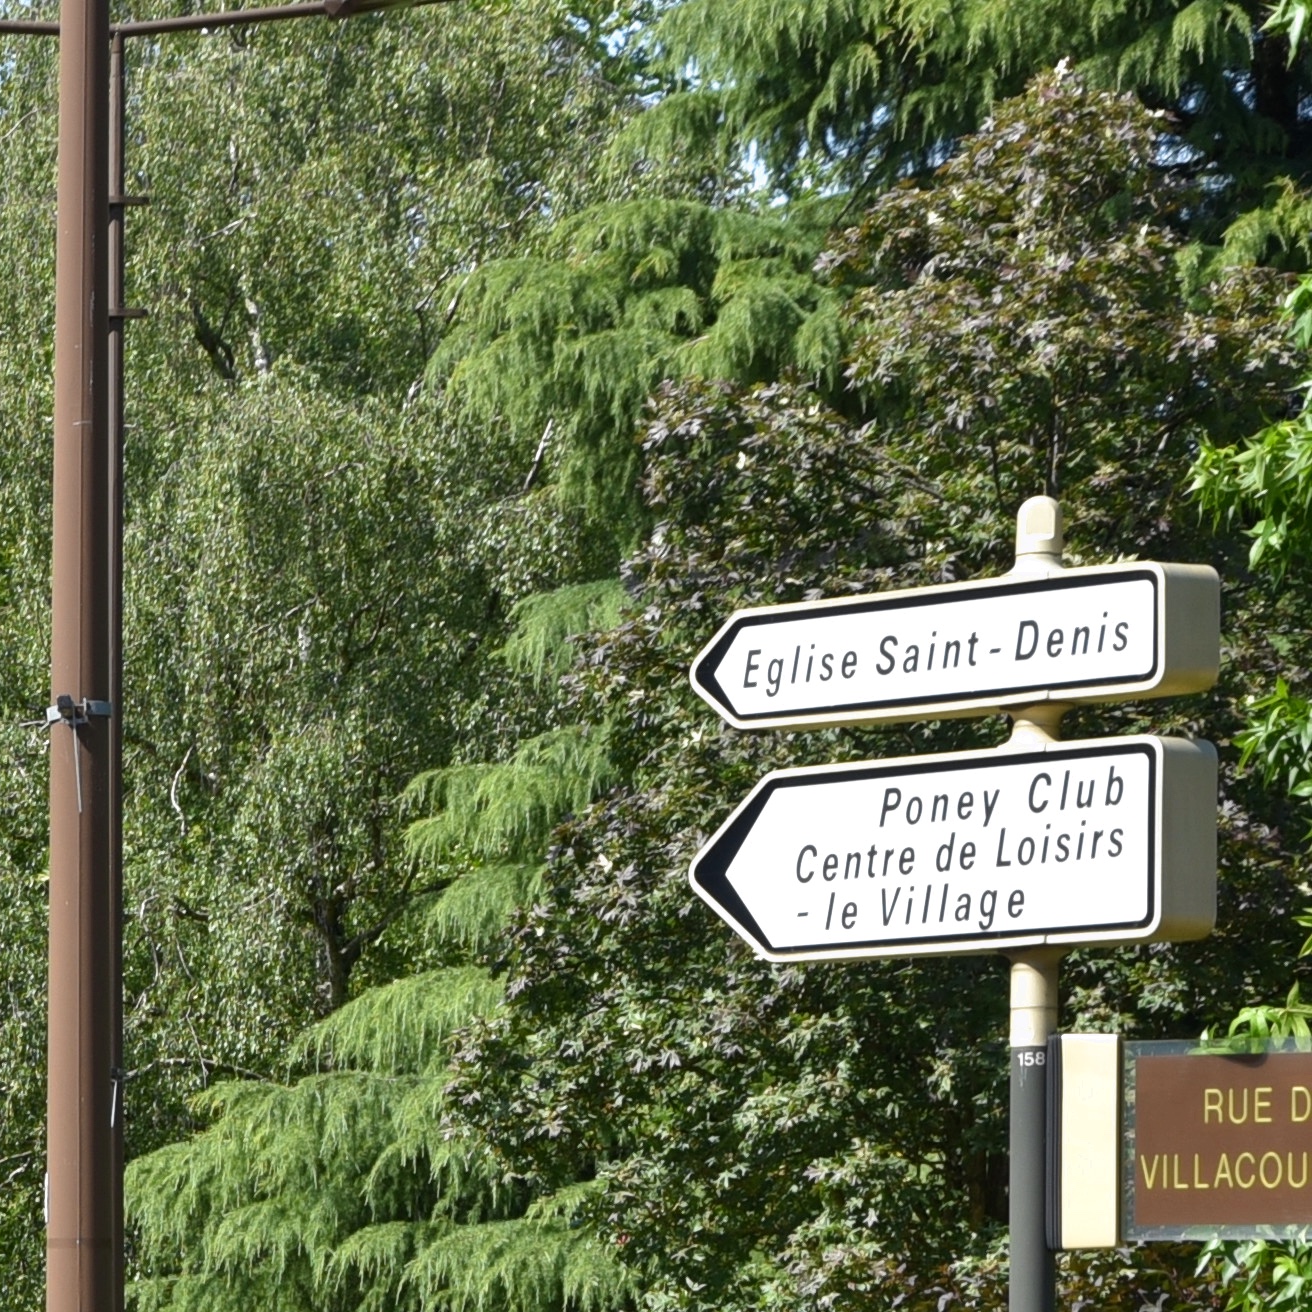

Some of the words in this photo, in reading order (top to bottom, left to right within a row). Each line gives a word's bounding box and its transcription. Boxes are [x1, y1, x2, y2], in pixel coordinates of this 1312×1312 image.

[742, 644, 858, 698] Eglise
[878, 789, 1001, 829] Poney
[1027, 765, 1124, 814] Club
[795, 844, 916, 885] Centre
[934, 832, 976, 873] de
[996, 823, 1125, 868] Loisirs
[824, 892, 859, 931] le
[879, 882, 1026, 931] Village
[1017, 1051, 1045, 1067] 158
[1204, 1086, 1273, 1124] RUE
